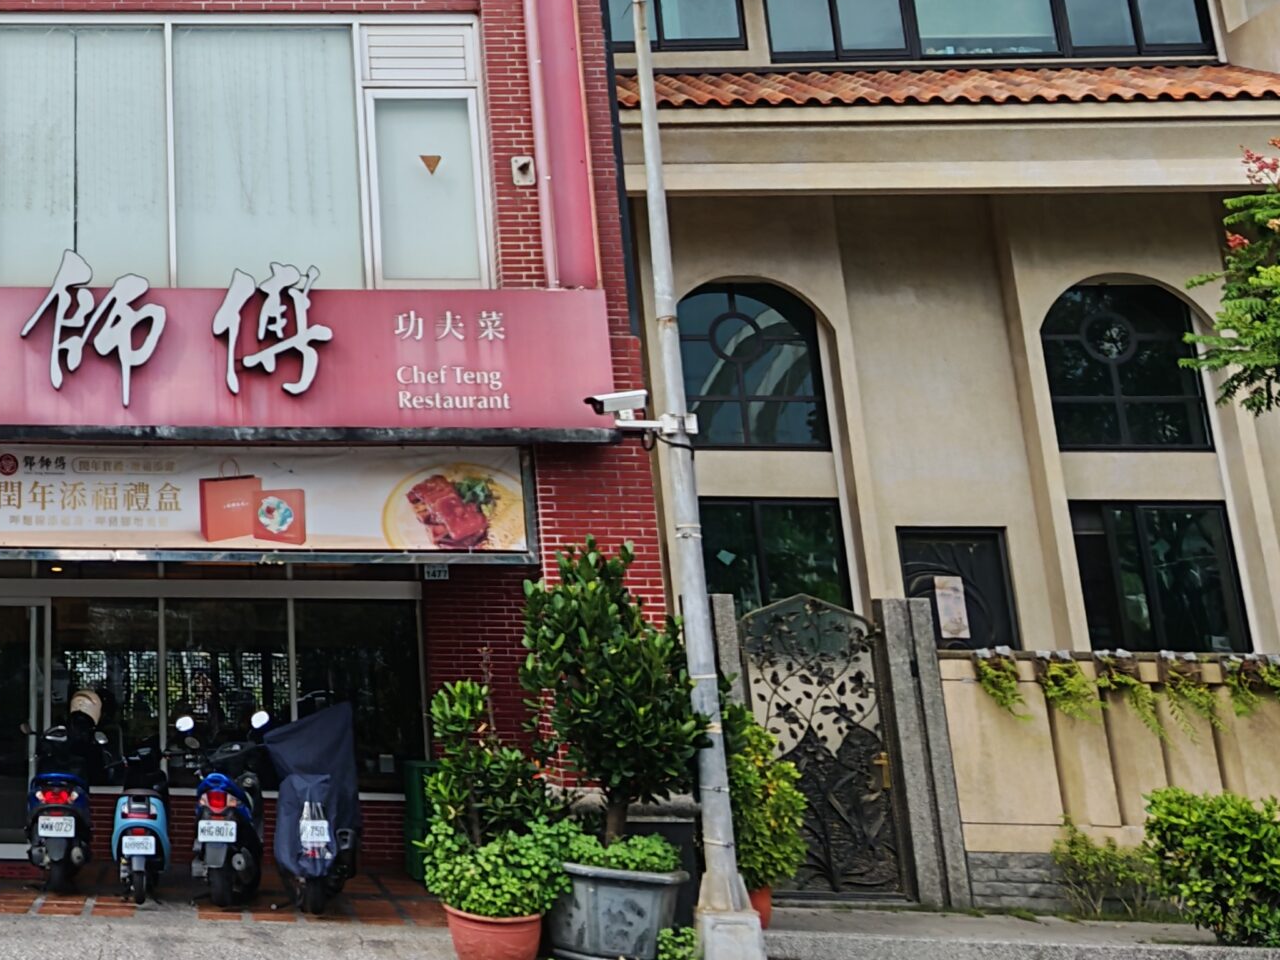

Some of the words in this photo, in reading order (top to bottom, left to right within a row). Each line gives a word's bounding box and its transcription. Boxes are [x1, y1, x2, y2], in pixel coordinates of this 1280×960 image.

[394, 310, 505, 340] 功夫菜
[396, 365, 448, 384] Chef
[451, 366, 503, 390] Teng
[398, 390, 511, 409] Restaurant
